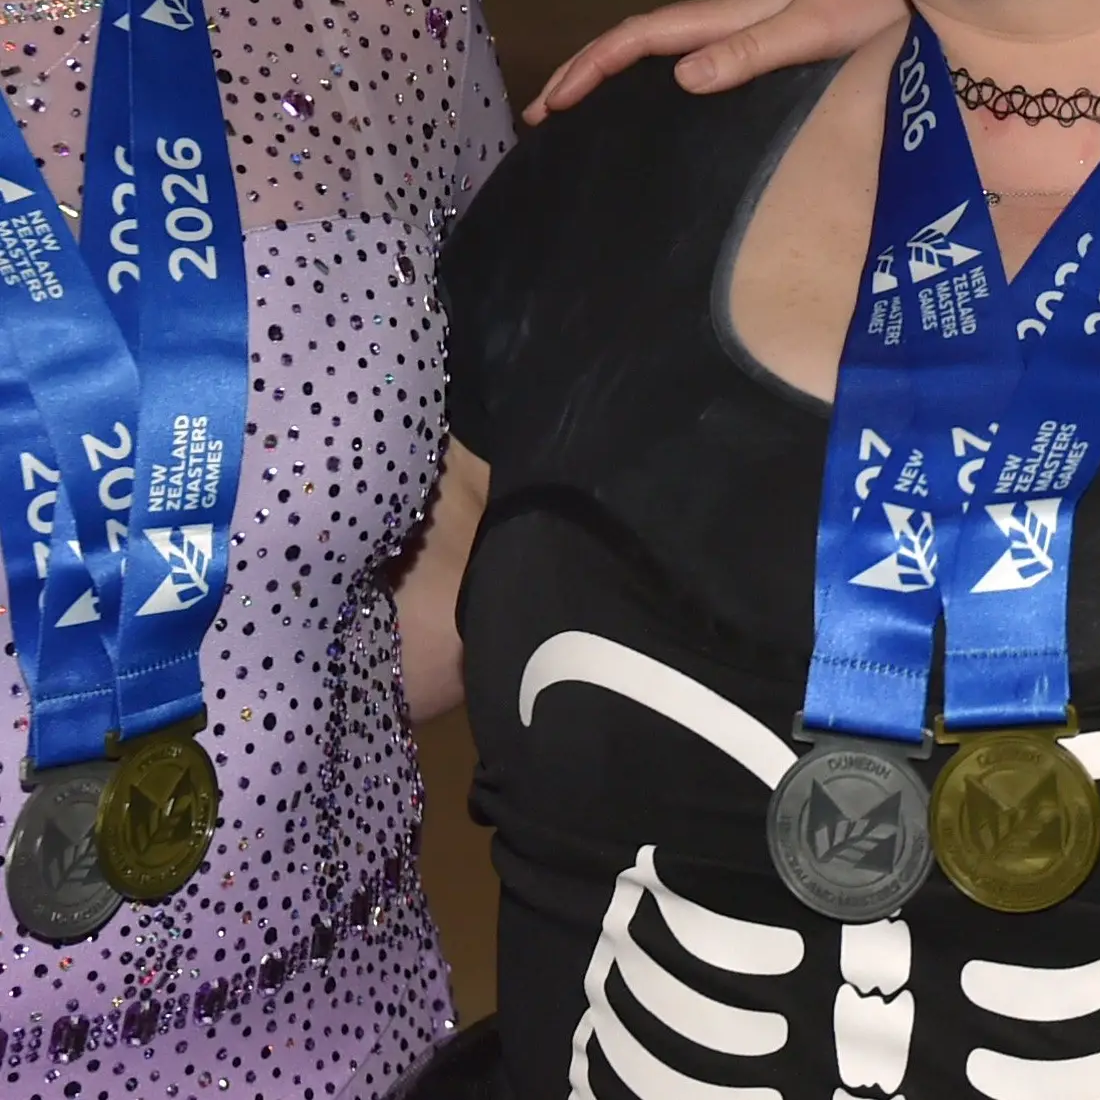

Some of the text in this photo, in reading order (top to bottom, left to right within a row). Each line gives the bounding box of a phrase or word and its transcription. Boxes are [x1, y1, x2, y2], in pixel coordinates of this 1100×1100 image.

[900, 35, 937, 152] 2026
[27, 210, 61, 251] NEW
[156, 137, 218, 282] 2026
[0, 220, 48, 302] MASTERS
[11, 215, 64, 299] ZEALAND
[969, 265, 990, 299] NEW
[867, 300, 889, 334] GAMES
[917, 288, 938, 331] GAMES
[935, 280, 959, 339] MASTERS
[953, 273, 977, 335] ZEALAND
[165, 415, 190, 511] ZEALAND
[184, 416, 208, 510] MASTERS
[201, 439, 223, 508] GAMES
[893, 449, 925, 493] NEW
[993, 454, 1023, 494] NEW
[1013, 420, 1057, 493] ZEALAND
[1032, 423, 1077, 492] MASTERS
[1053, 441, 1089, 490] GAMES
[147, 465, 168, 513] NEW
